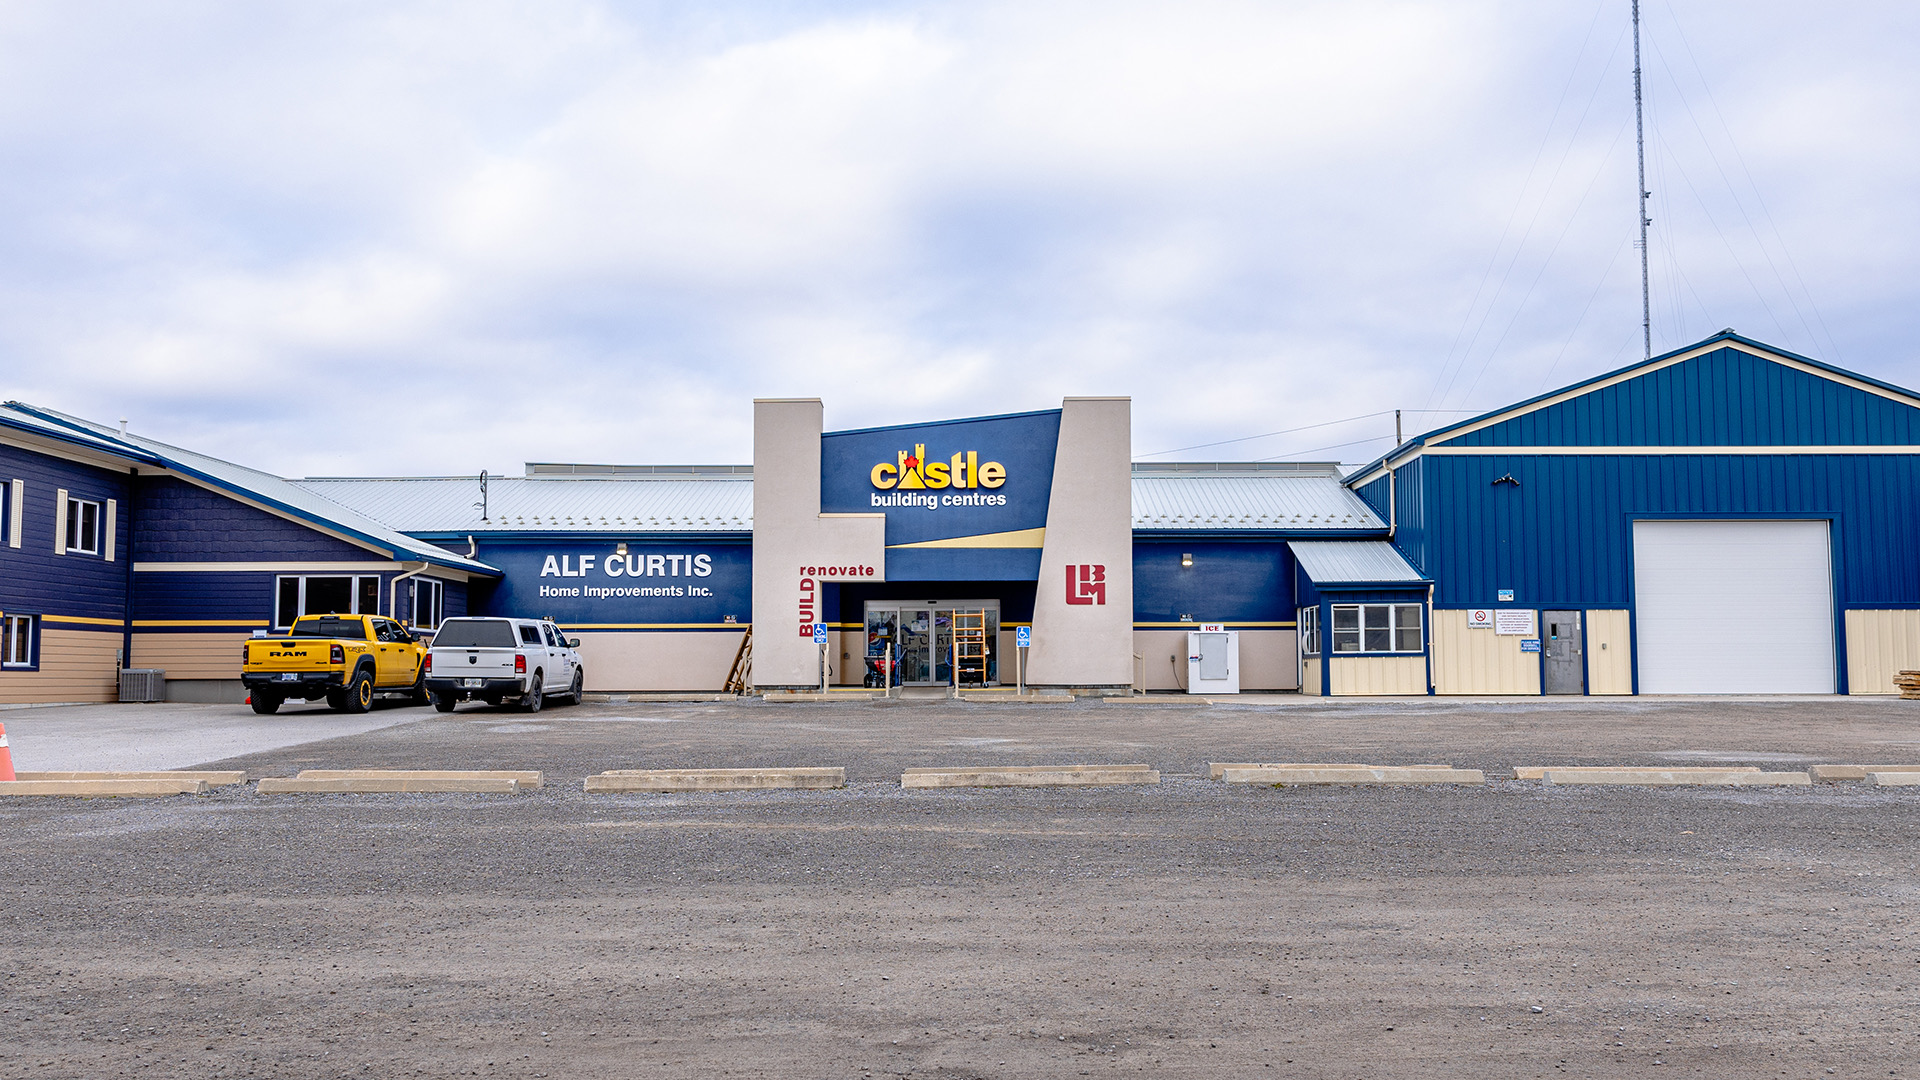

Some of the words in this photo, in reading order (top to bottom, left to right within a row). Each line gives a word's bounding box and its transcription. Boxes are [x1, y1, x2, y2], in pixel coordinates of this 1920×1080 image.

[871, 443, 1006, 489] castle
[871, 493, 938, 509] building
[942, 493, 1007, 506] centres
[540, 555, 596, 577] ALF
[604, 554, 713, 577] CURTIS
[800, 565, 874, 576] renovate
[539, 585, 580, 597] Home
[584, 585, 684, 600] Improvements
[687, 585, 713, 597] Inc.
[799, 578, 814, 637] BUILD
